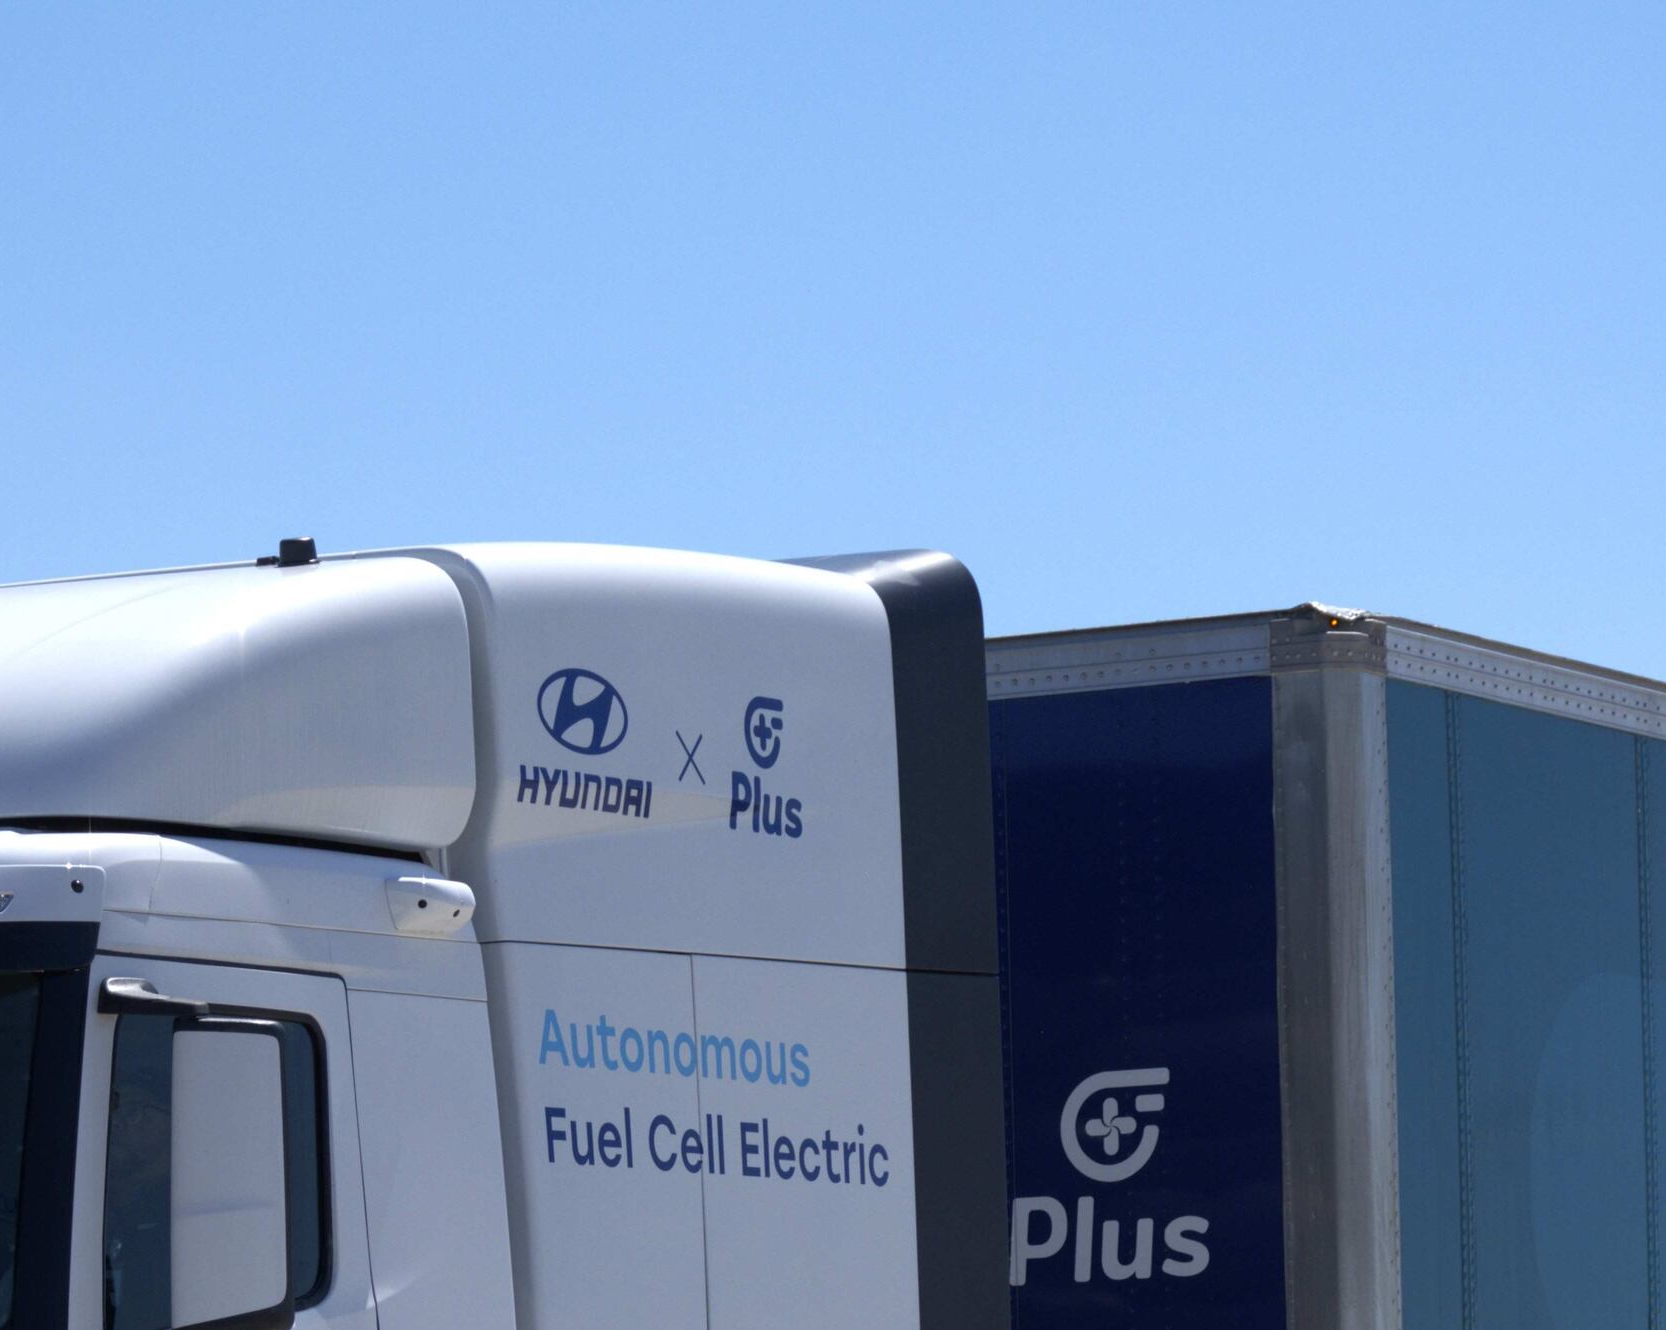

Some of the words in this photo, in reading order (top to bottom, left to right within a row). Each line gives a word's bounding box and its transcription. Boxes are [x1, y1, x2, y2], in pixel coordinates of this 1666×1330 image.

[516, 764, 653, 819] HYUNDAI
[728, 770, 804, 839] Plus
[539, 1008, 811, 1088] Autonomous
[544, 1106, 634, 1169] Fuel
[648, 1113, 726, 1176] Cell
[739, 1117, 890, 1188] Electric
[1009, 1196, 1210, 1286] Plus
